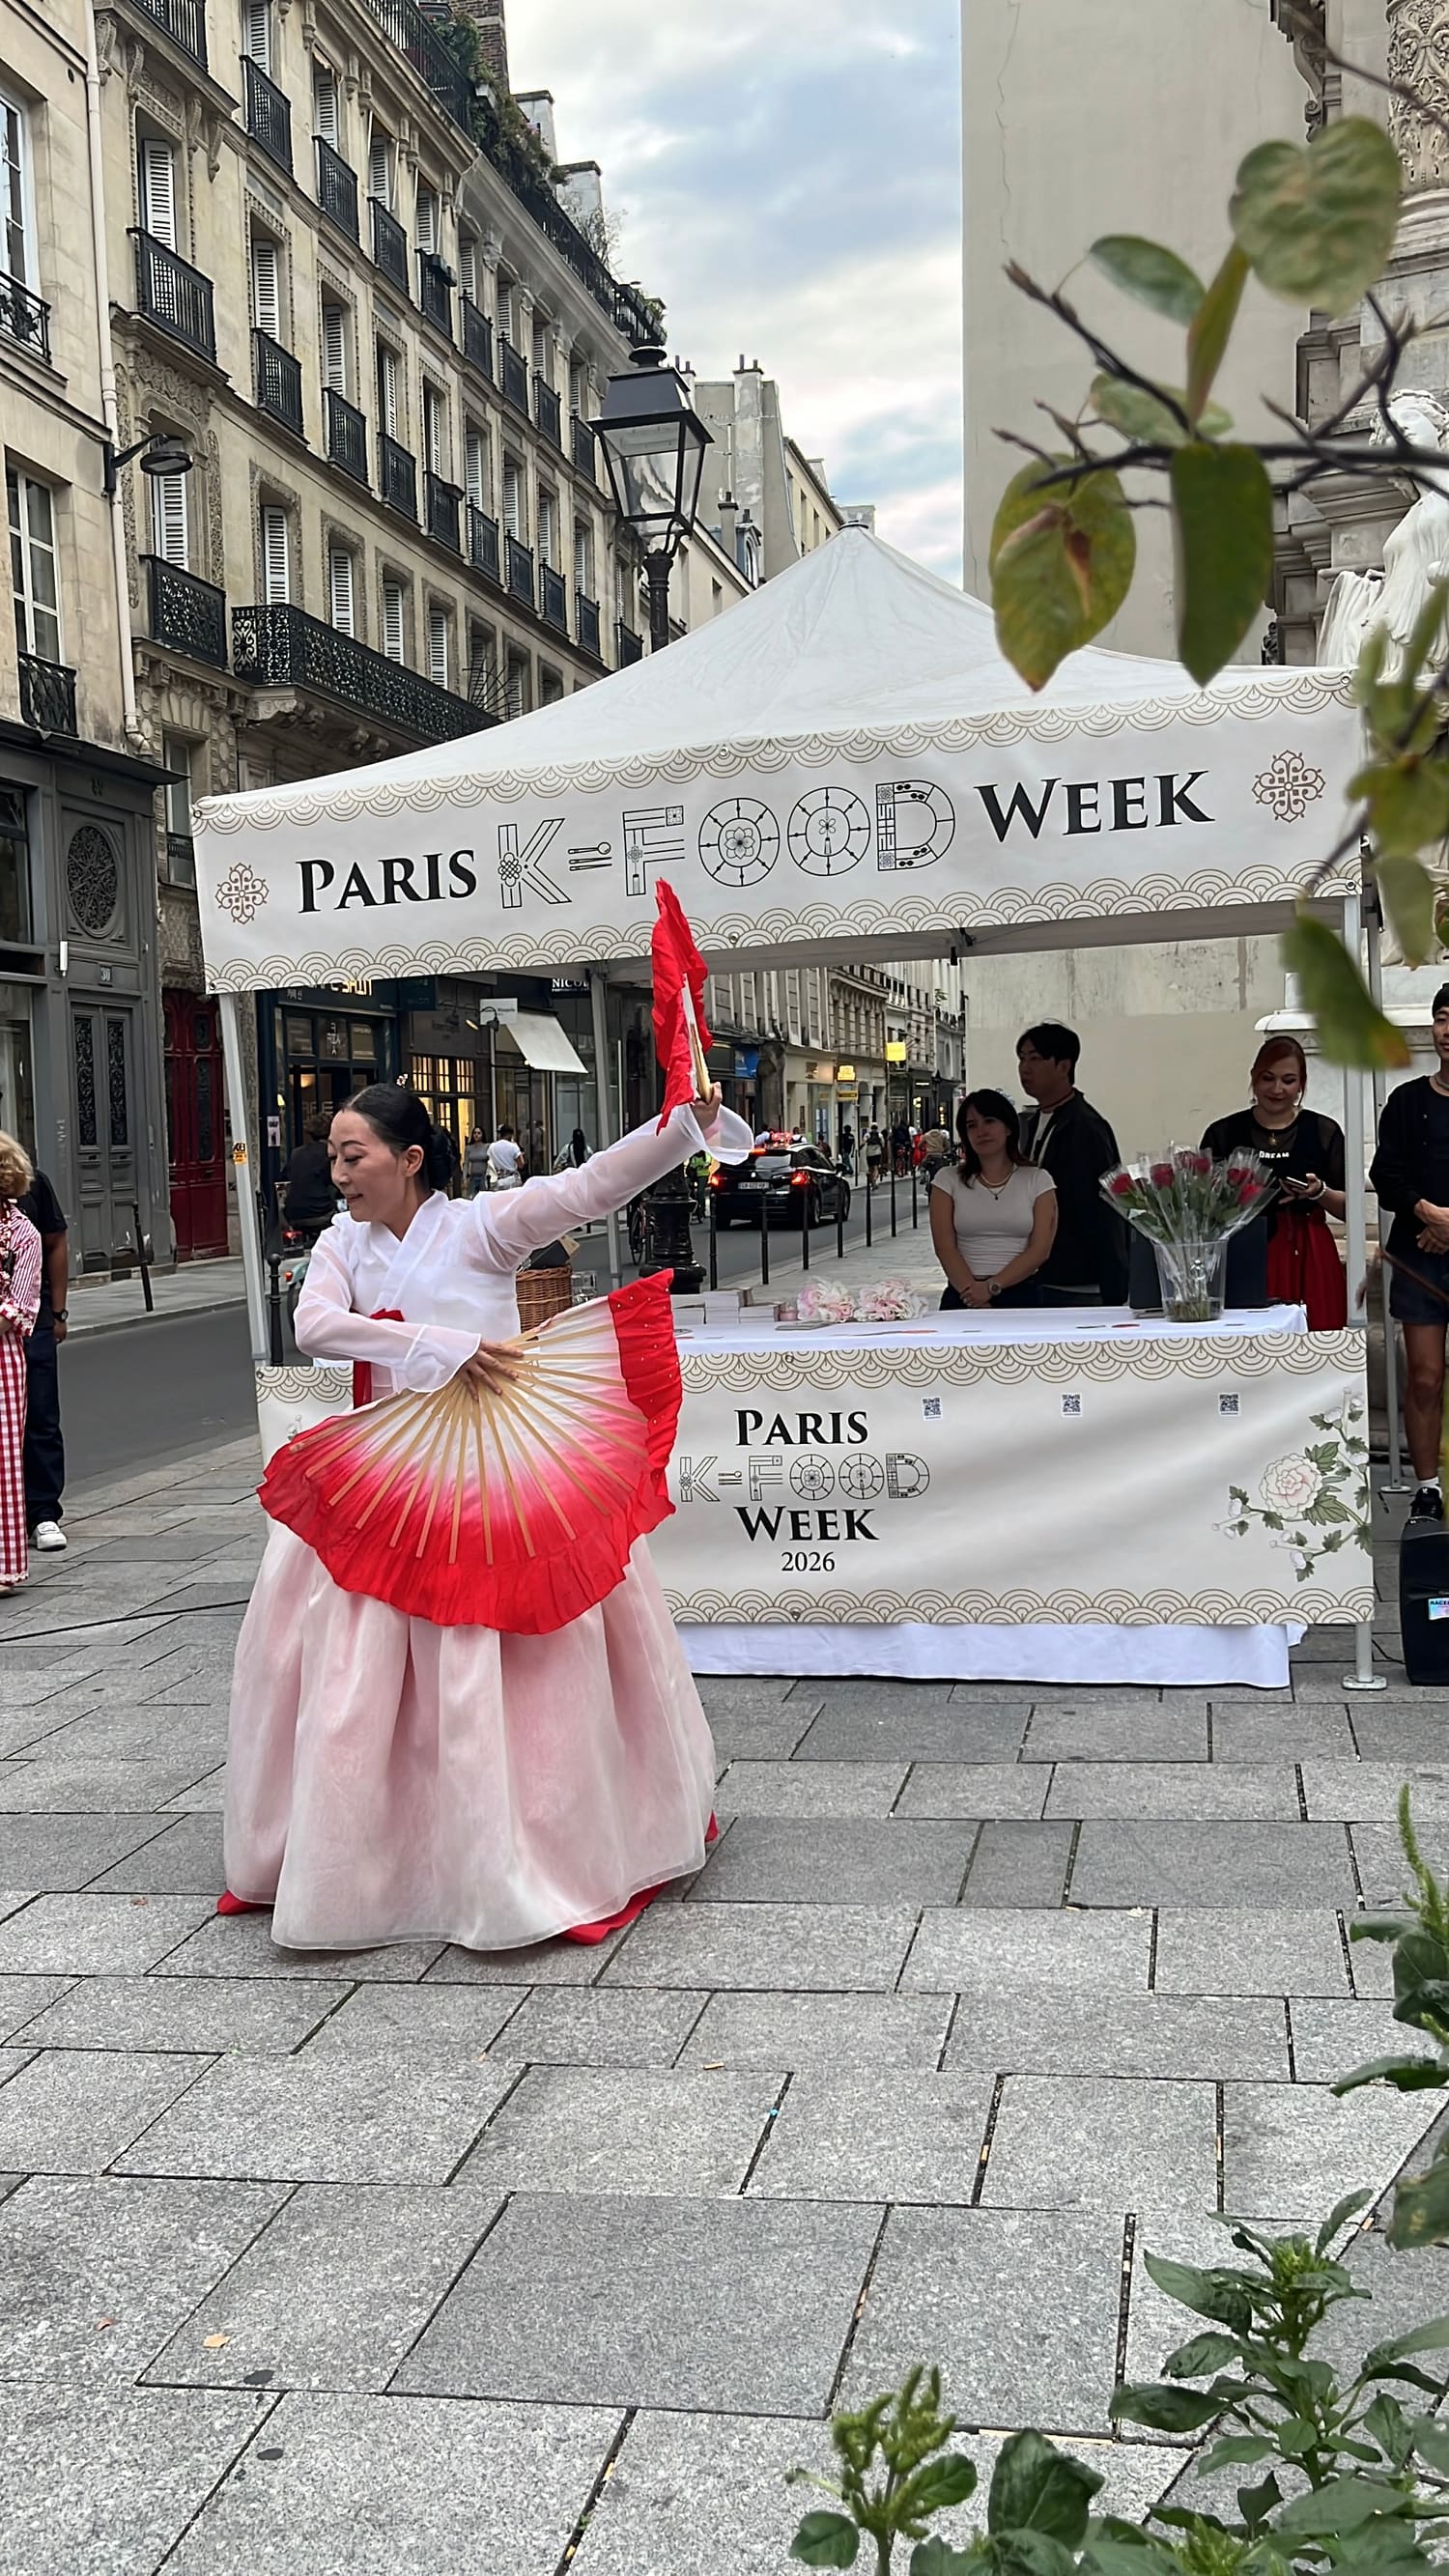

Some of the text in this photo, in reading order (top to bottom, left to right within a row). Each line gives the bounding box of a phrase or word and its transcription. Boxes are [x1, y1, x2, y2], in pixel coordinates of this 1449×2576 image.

[297, 849, 477, 914] PARIS
[974, 770, 1216, 843] WEEK
[1259, 1150, 1290, 1159] DREAM
[734, 1409, 868, 1446] PARIS
[679, 1453, 930, 1503] K-FOOD
[733, 1505, 881, 1543] WEEK
[781, 1551, 836, 1572] 2026
